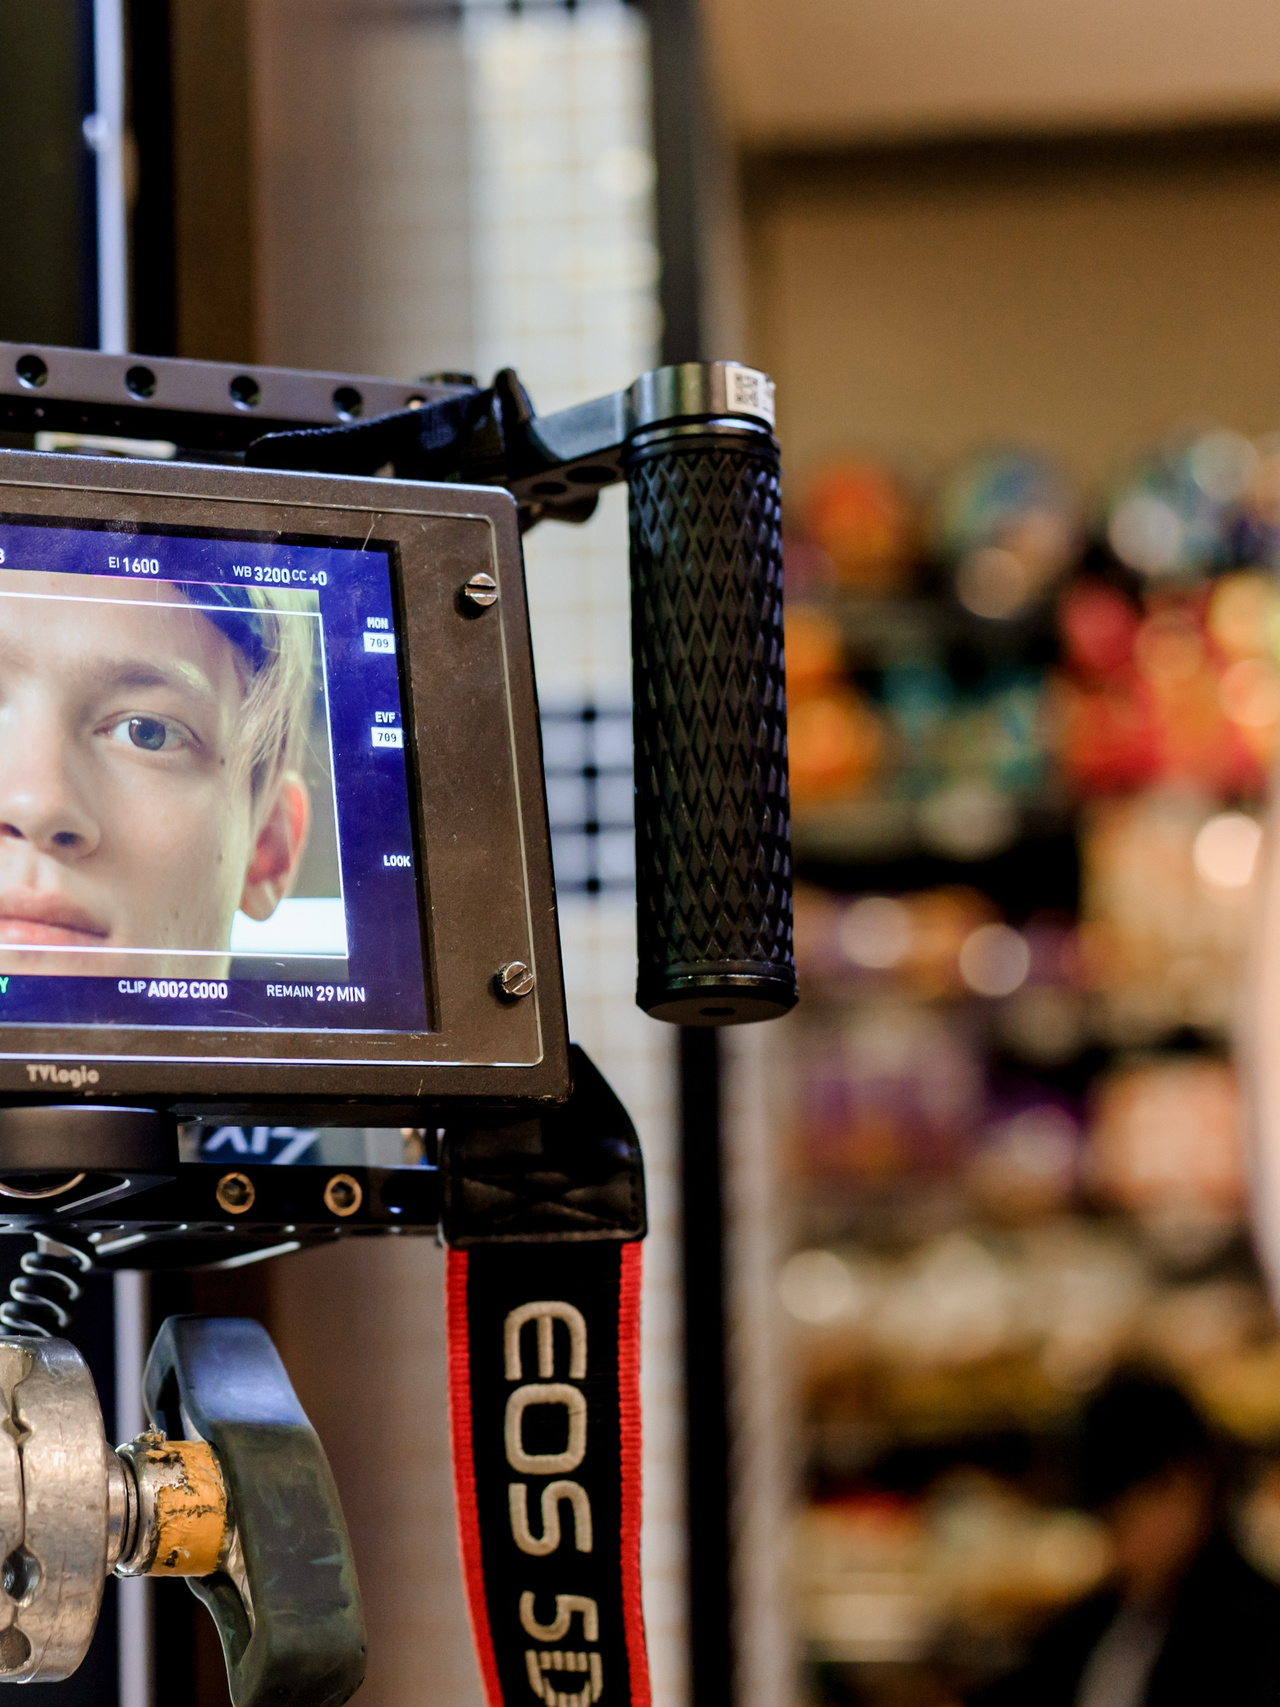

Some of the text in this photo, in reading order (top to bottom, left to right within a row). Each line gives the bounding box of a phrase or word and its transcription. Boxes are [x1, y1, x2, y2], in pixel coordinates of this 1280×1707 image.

[109, 556, 159, 575] EI 1600
[233, 565, 327, 586] WB 3200 CC +0
[367, 617, 389, 630] MON
[370, 638, 389, 649] 709
[375, 711, 396, 724] EVF
[377, 732, 397, 743] 709
[383, 855, 411, 867] LOOK
[118, 980, 146, 994] CLIP
[267, 984, 365, 1002] REMAIN 29 MIN
[503, 1300, 604, 1707] EOS 5D
